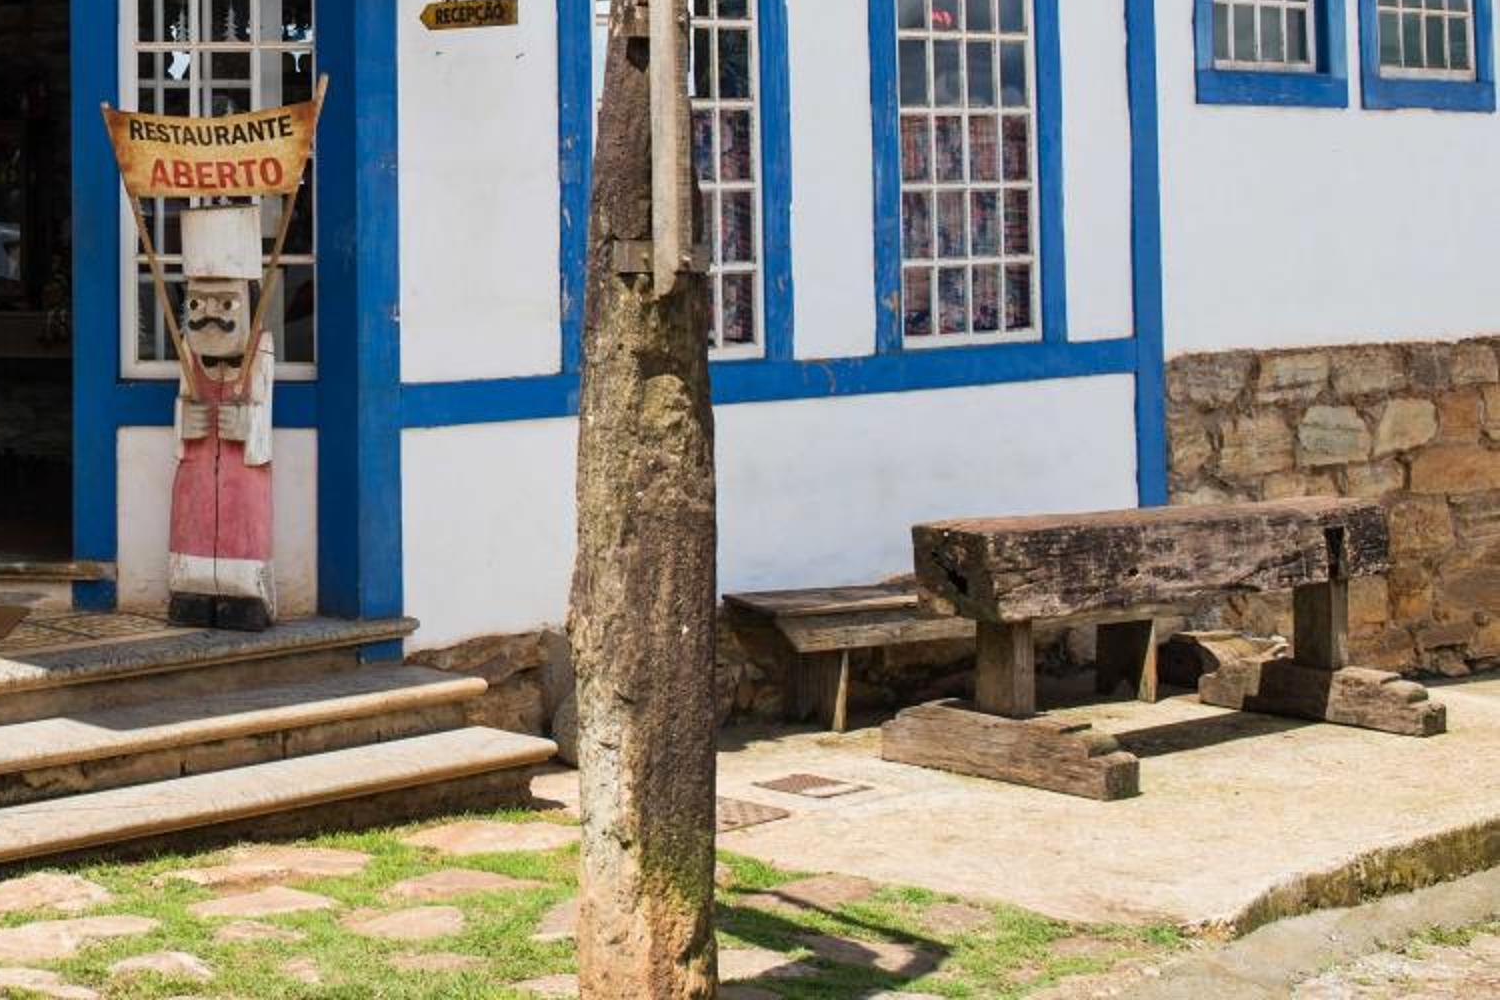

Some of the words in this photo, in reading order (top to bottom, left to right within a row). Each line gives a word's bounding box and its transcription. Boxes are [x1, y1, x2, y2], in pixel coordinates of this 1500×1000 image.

[435, 2, 504, 25] RECEPÇÃO
[129, 115, 293, 146] RESTAURANTE
[150, 157, 284, 189] ABERTO
